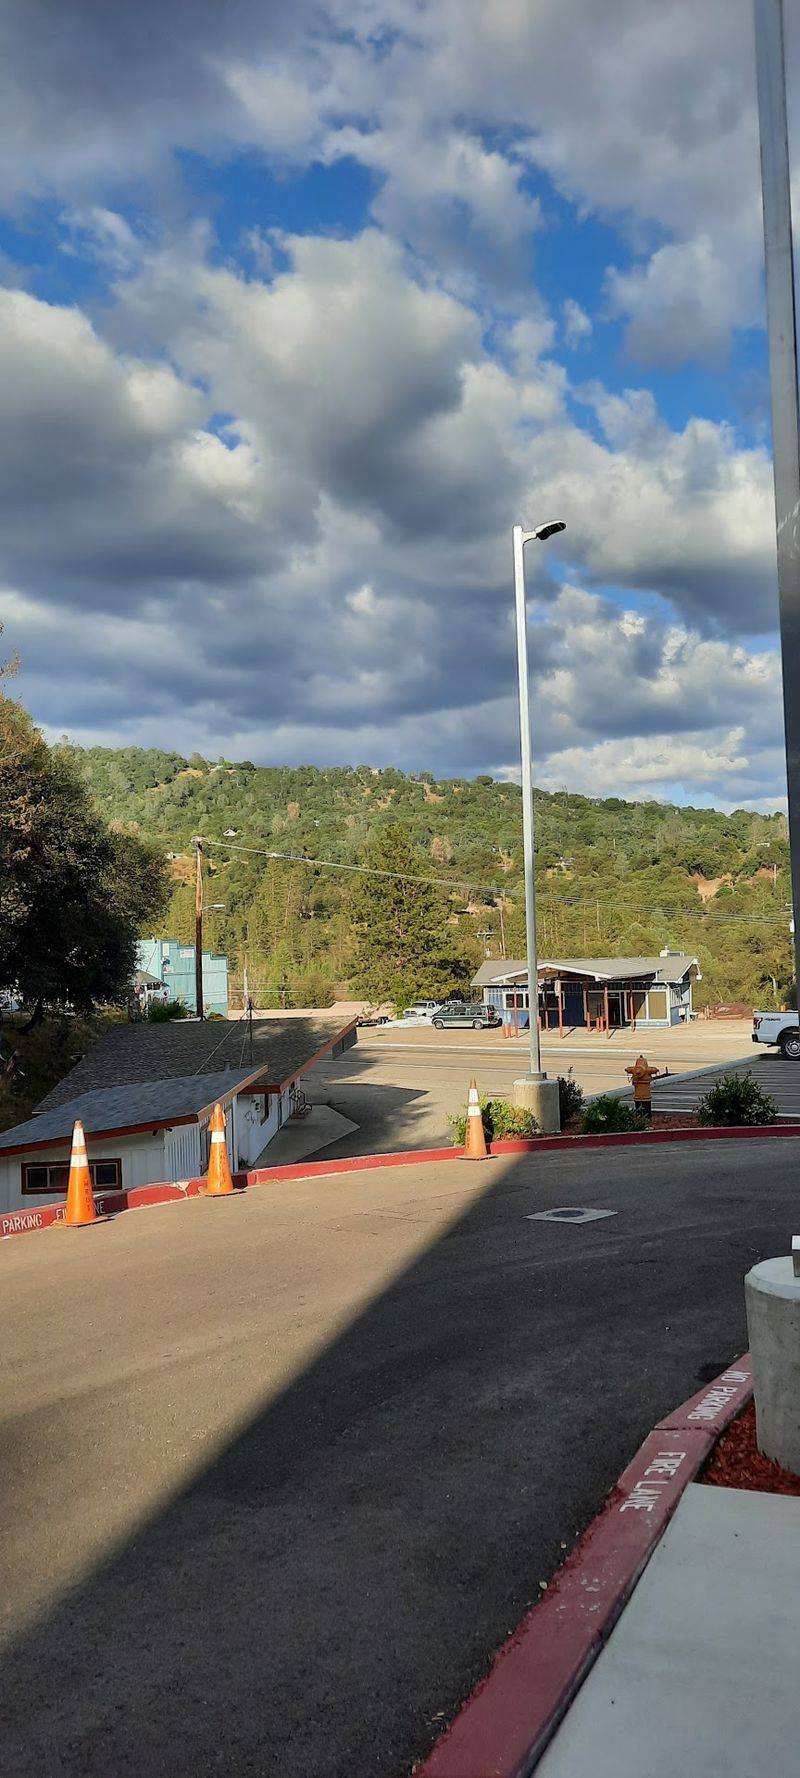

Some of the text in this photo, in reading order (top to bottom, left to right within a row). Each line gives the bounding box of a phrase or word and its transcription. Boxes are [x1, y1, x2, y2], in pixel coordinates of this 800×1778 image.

[2, 1213, 42, 1234] PARKING
[686, 1370, 751, 1421] NO PARKING
[619, 1451, 686, 1512] FIRE LANE
